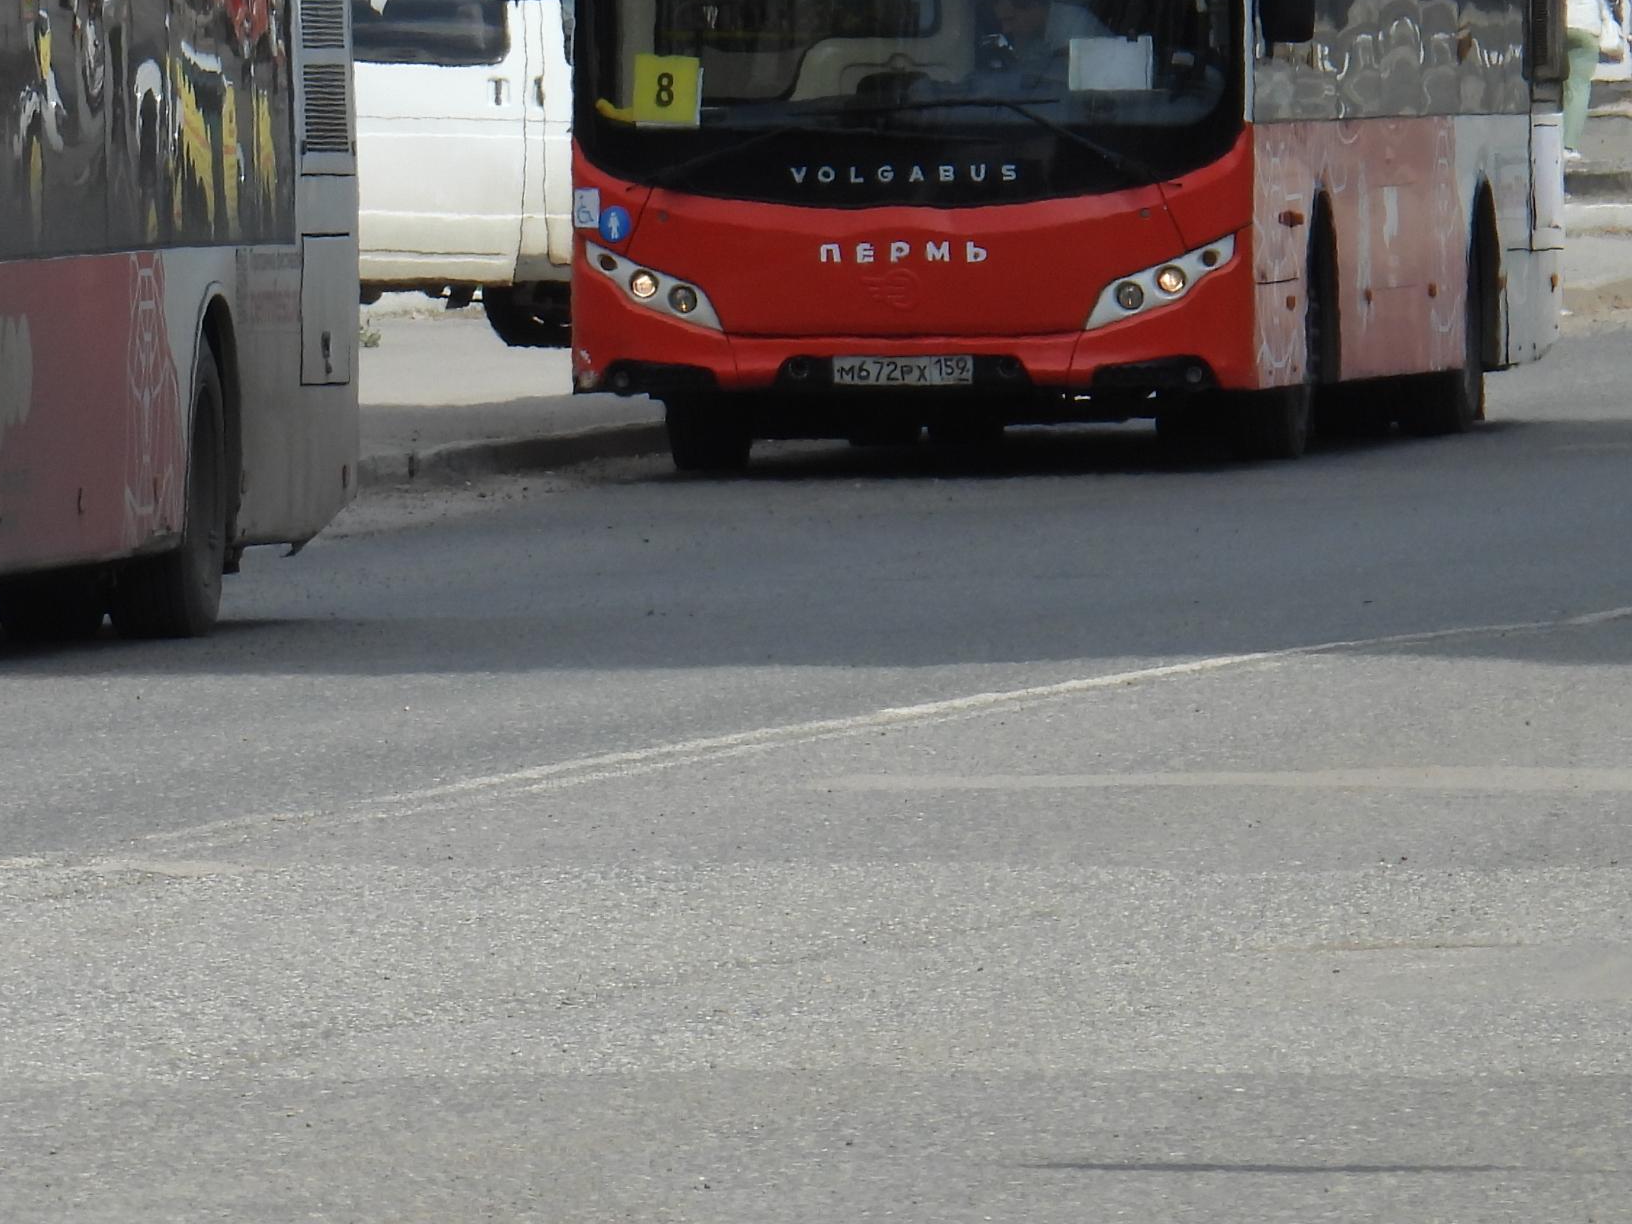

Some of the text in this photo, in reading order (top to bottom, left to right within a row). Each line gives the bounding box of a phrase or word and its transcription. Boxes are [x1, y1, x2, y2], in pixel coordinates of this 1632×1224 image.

[656, 72, 674, 108] 8
[791, 164, 1018, 184] VOLGABUS
[819, 241, 988, 263] ПЕРМЬ
[934, 357, 968, 378] 159
